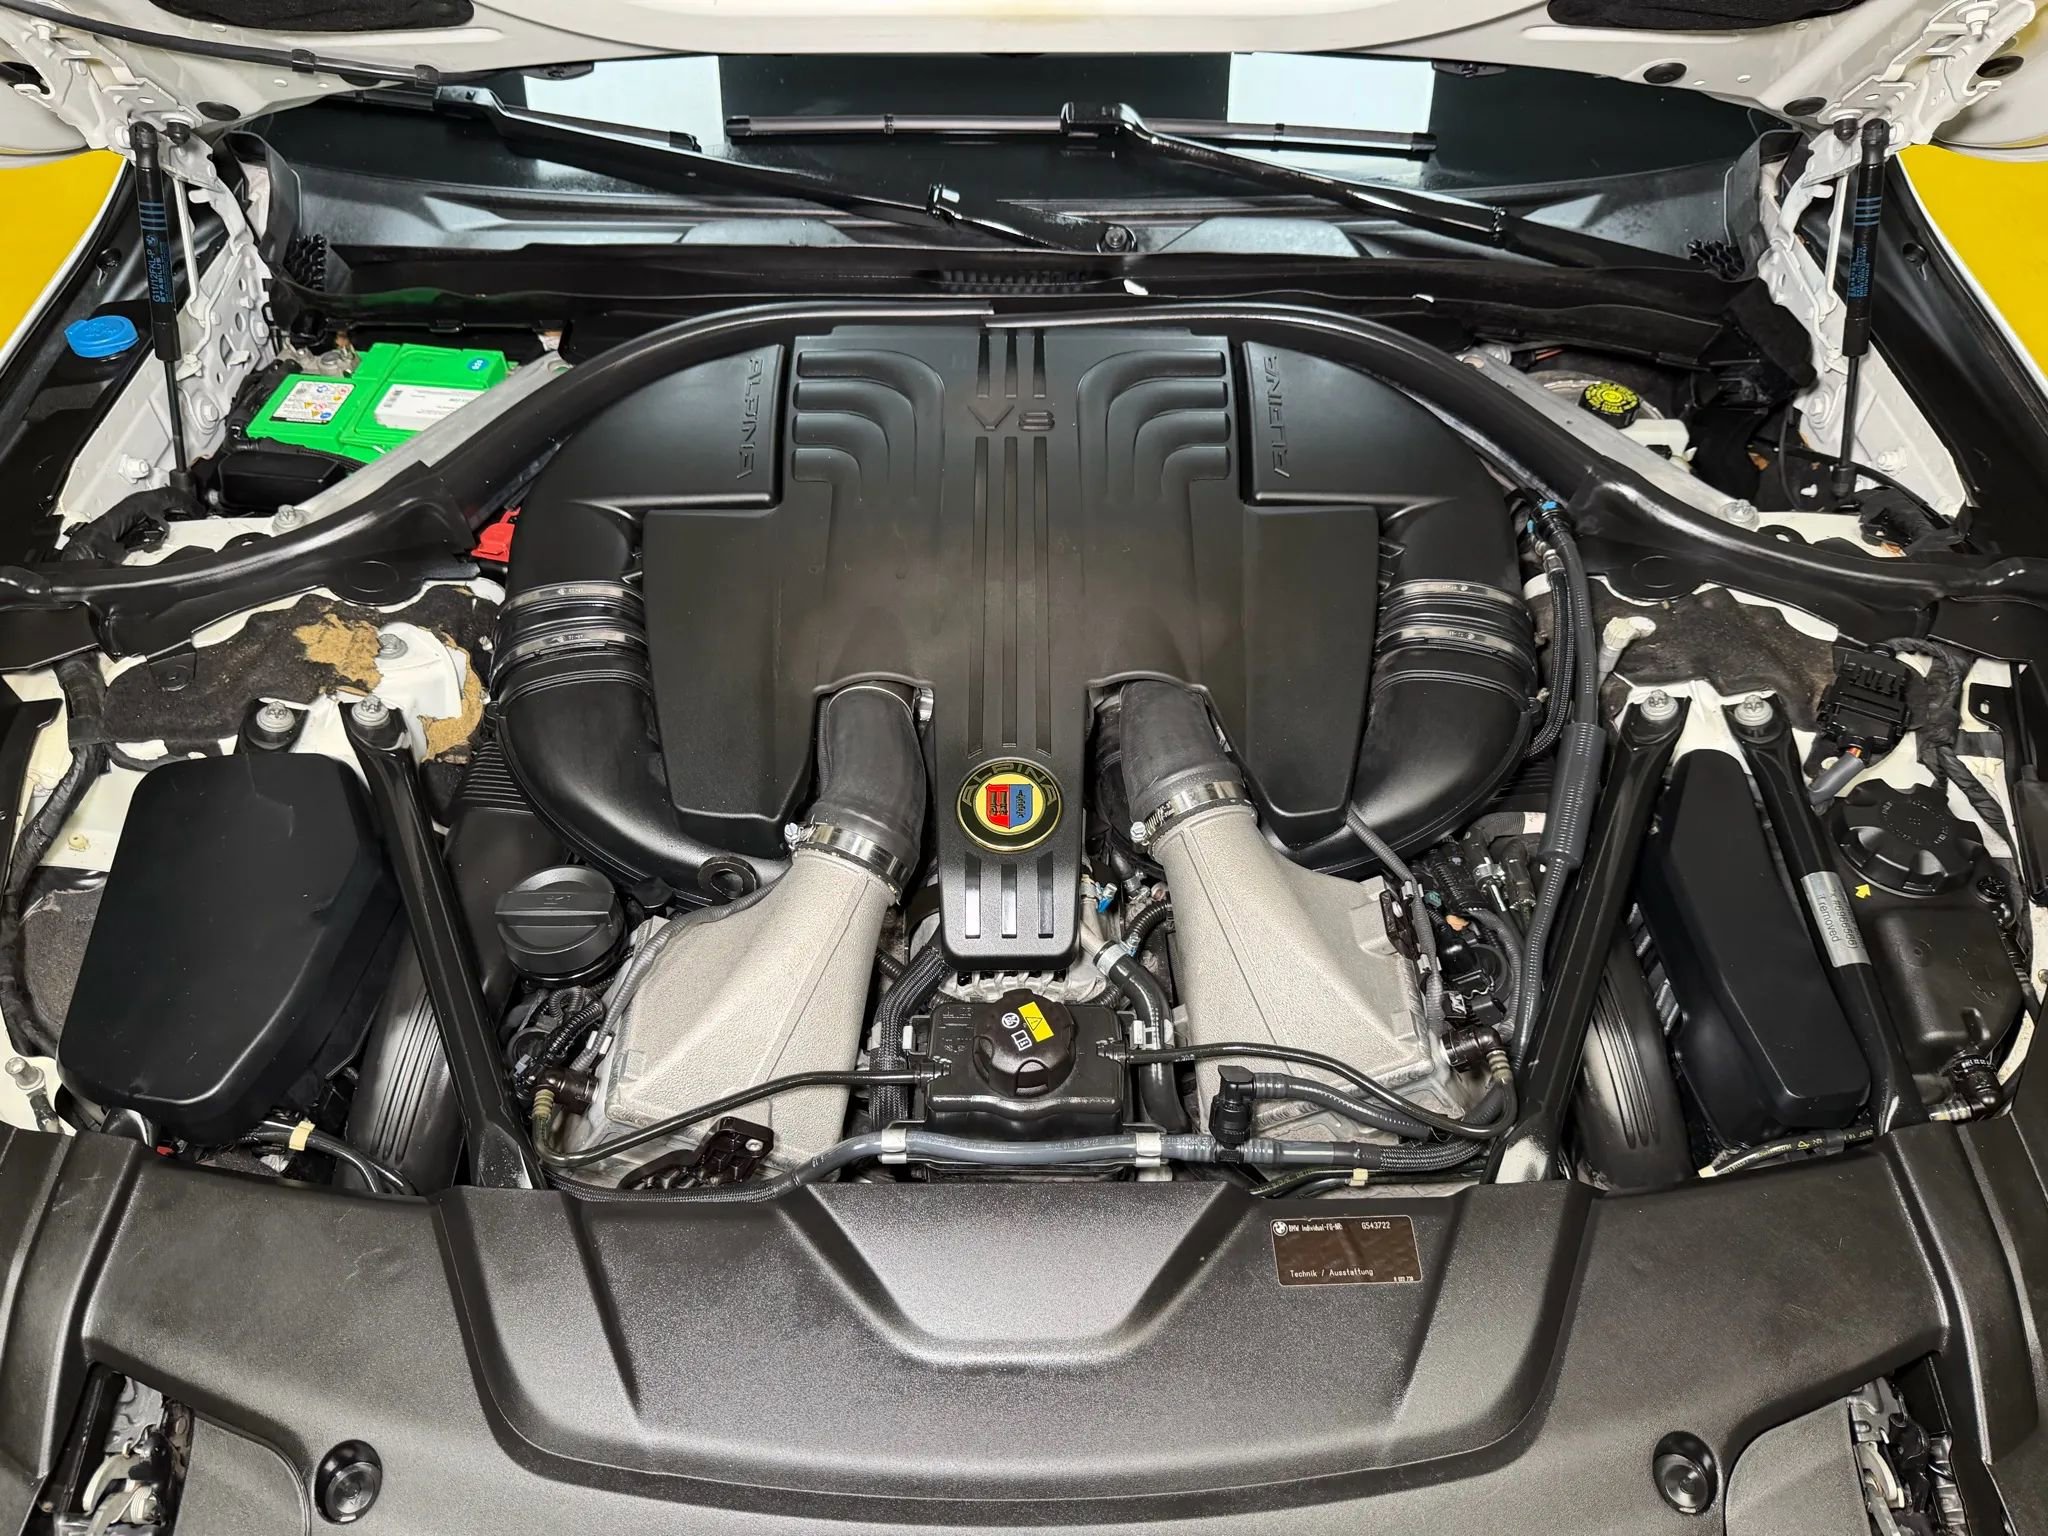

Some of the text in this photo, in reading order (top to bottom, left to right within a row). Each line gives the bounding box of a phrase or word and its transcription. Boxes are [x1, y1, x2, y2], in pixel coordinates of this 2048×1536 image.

[737, 358, 763, 480] ALPINA
[966, 404, 1055, 431] V8
[1264, 356, 1290, 478] ALPINA
[961, 763, 1058, 807] ALPINA
[1819, 901, 1841, 942] removed
[1288, 1224, 1300, 1233] BMW
[1289, 1269, 1318, 1278] Technik
[1329, 1269, 1374, 1277] Ausstattung
